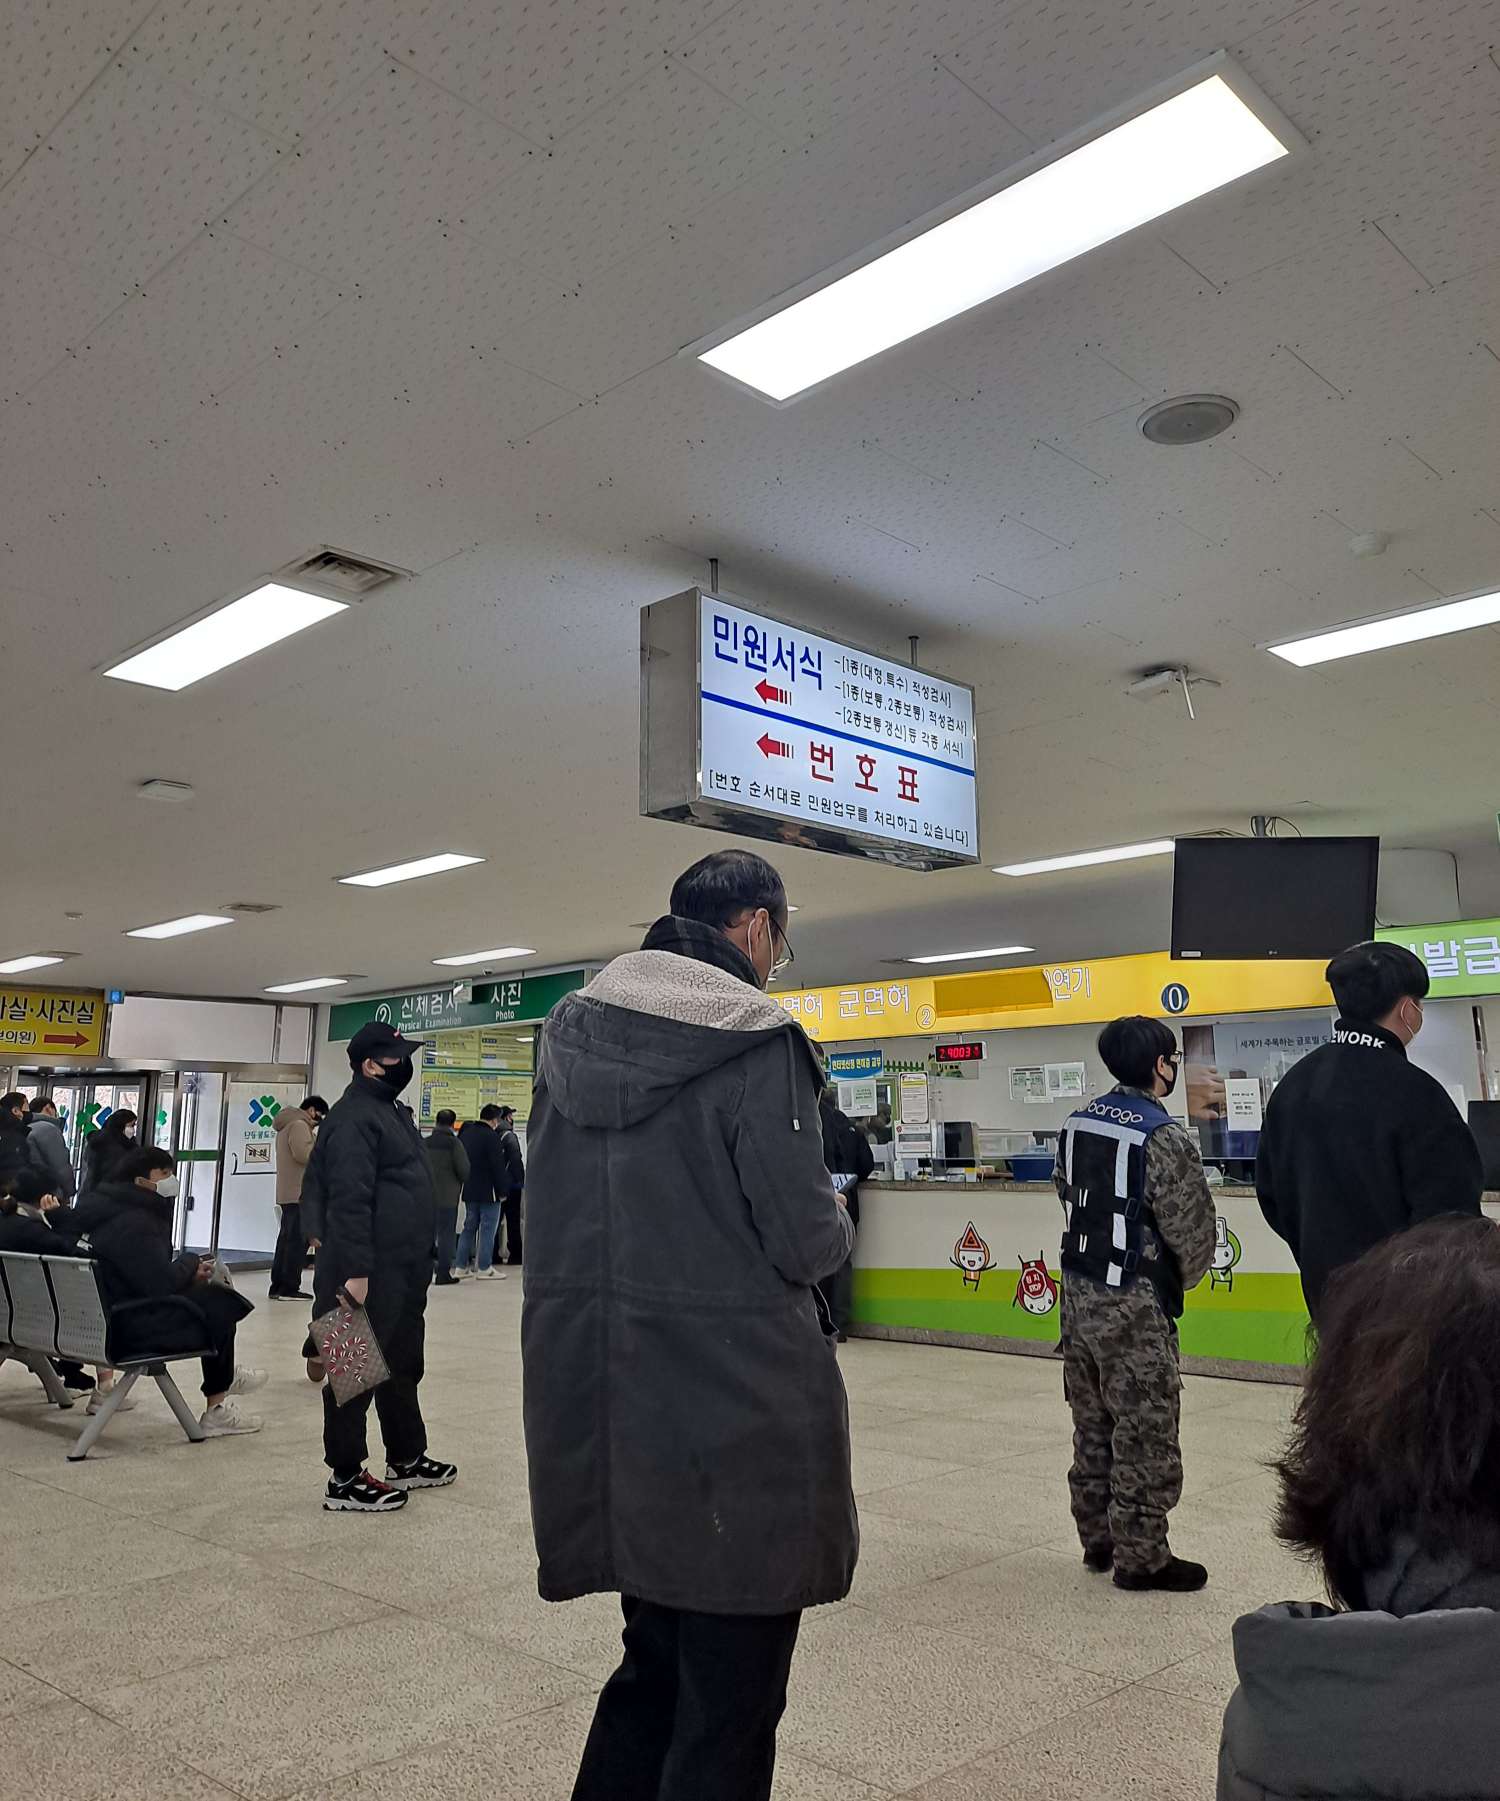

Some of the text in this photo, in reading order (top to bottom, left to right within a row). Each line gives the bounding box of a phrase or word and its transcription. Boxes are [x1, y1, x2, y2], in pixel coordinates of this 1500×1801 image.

[713, 614, 822, 691] 민원서식
[709, 769, 969, 848] [번호 순서대로 민원업무를 처리하고 있습니다]
[490, 982, 522, 1007] 사진
[839, 984, 910, 1018] 군면허
[425, 1015, 462, 1029] Examination
[495, 1010, 515, 1021] Photo
[1087, 1100, 1144, 1124] barogo
